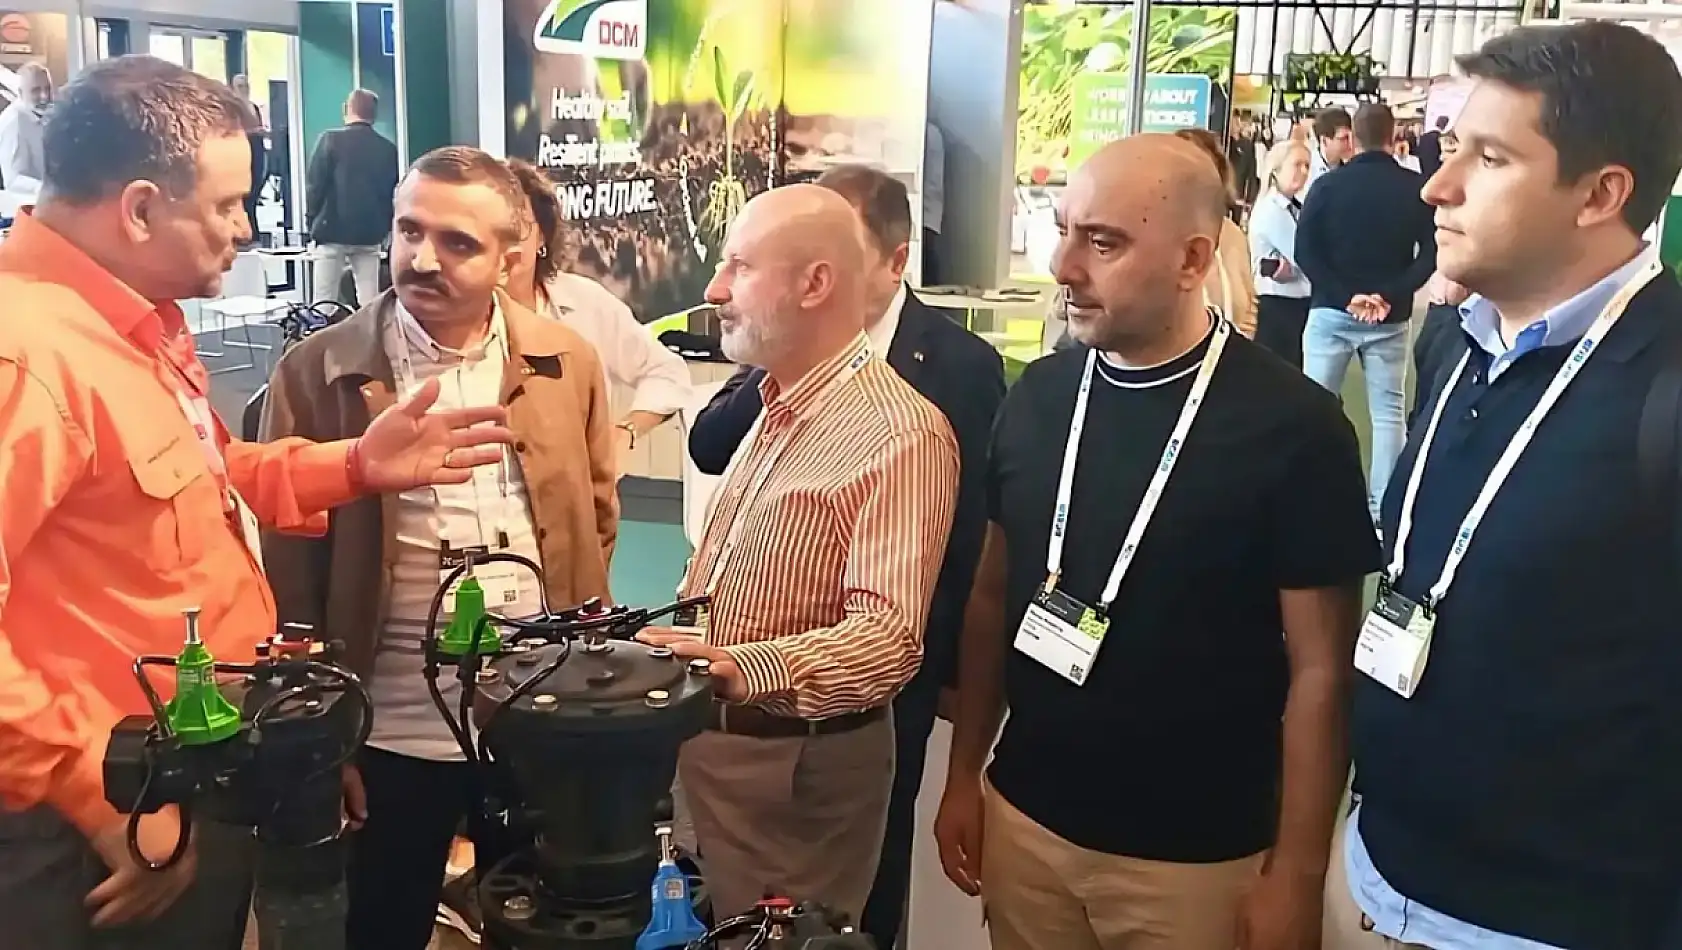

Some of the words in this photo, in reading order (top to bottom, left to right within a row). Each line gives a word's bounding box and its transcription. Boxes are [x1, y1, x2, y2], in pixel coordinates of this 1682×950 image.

[599, 20, 639, 47] DCM
[1151, 89, 1199, 105] ABOUT
[595, 178, 657, 217] FUTURE
